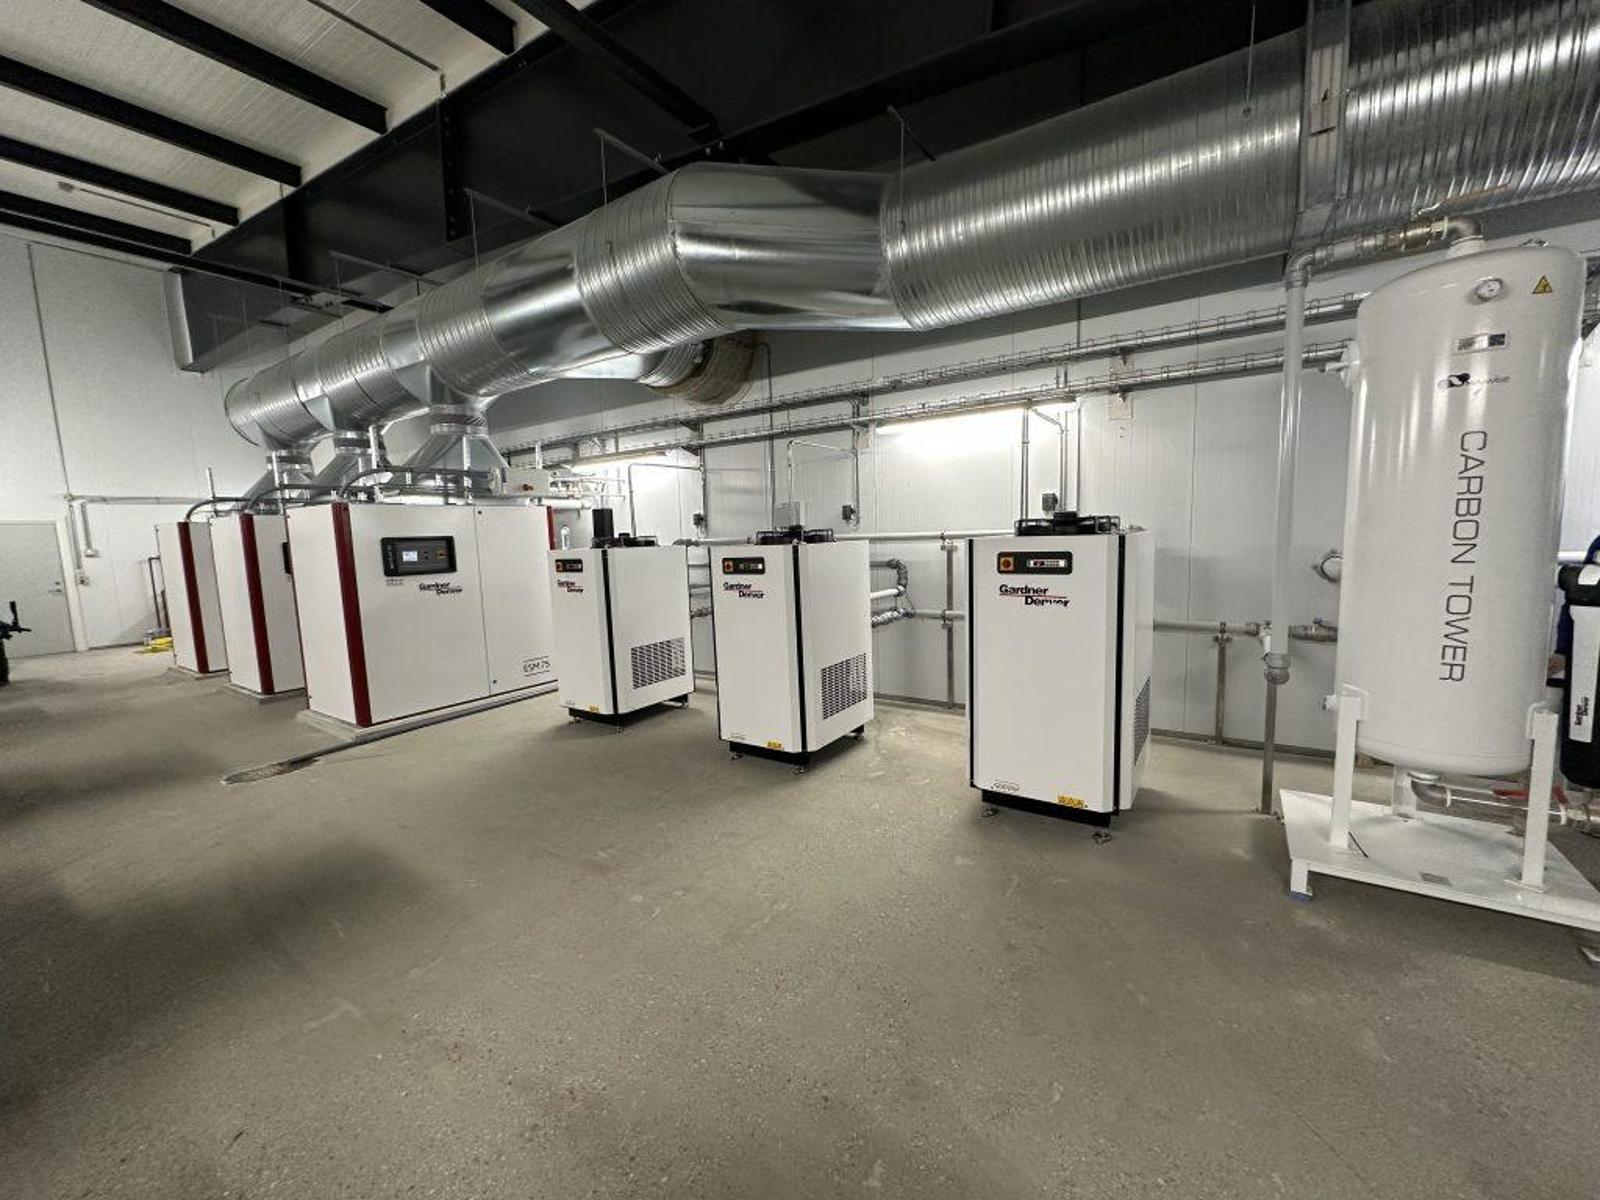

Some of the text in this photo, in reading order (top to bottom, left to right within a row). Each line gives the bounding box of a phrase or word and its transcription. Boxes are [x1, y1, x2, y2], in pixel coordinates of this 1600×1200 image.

[1439, 430, 1487, 682] CARBON TOWER
[722, 581, 752, 590] Gardner
[999, 584, 1048, 595] Gardner
